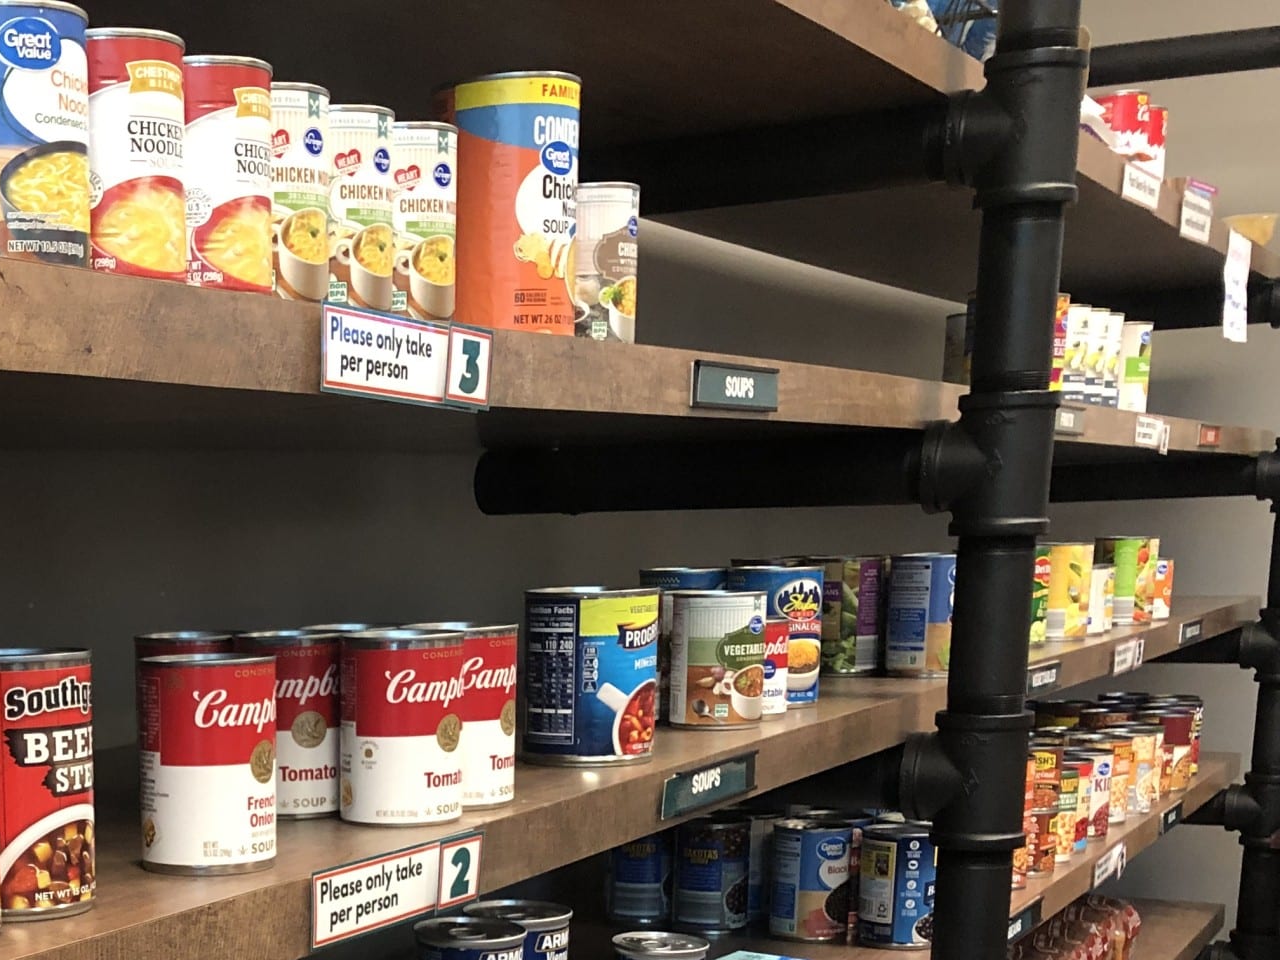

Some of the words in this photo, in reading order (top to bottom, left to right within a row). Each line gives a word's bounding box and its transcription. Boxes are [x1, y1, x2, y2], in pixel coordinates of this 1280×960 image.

[4, 28, 51, 49] Great
[16, 46, 52, 60] Value
[336, 152, 360, 167] HEART
[545, 148, 570, 162] Great
[396, 167, 419, 184] HEART
[340, 184, 384, 200] CHICKEN
[399, 198, 444, 214] CHICKEN
[543, 219, 569, 234] SOUP
[7, 239, 24, 253] NET
[513, 314, 529, 325] NET
[531, 315, 543, 325] WT
[330, 315, 373, 348] Please
[376, 333, 404, 360] only
[405, 332, 433, 359] take
[340, 353, 363, 378] per
[365, 357, 409, 381] person
[458, 338, 481, 394] 3
[725, 374, 754, 399] SOUPS
[554, 606, 573, 615] Facts
[559, 640, 573, 650] 240
[279, 765, 337, 783] Tomato
[691, 766, 721, 795] SOUPS
[293, 797, 327, 809] SOUP
[449, 846, 471, 899] 2
[319, 877, 362, 905] Please
[366, 863, 393, 891] only
[396, 857, 422, 882] take
[34, 891, 55, 901] NET
[56, 888, 70, 899] WT
[329, 905, 352, 932] per
[356, 892, 398, 924] person
